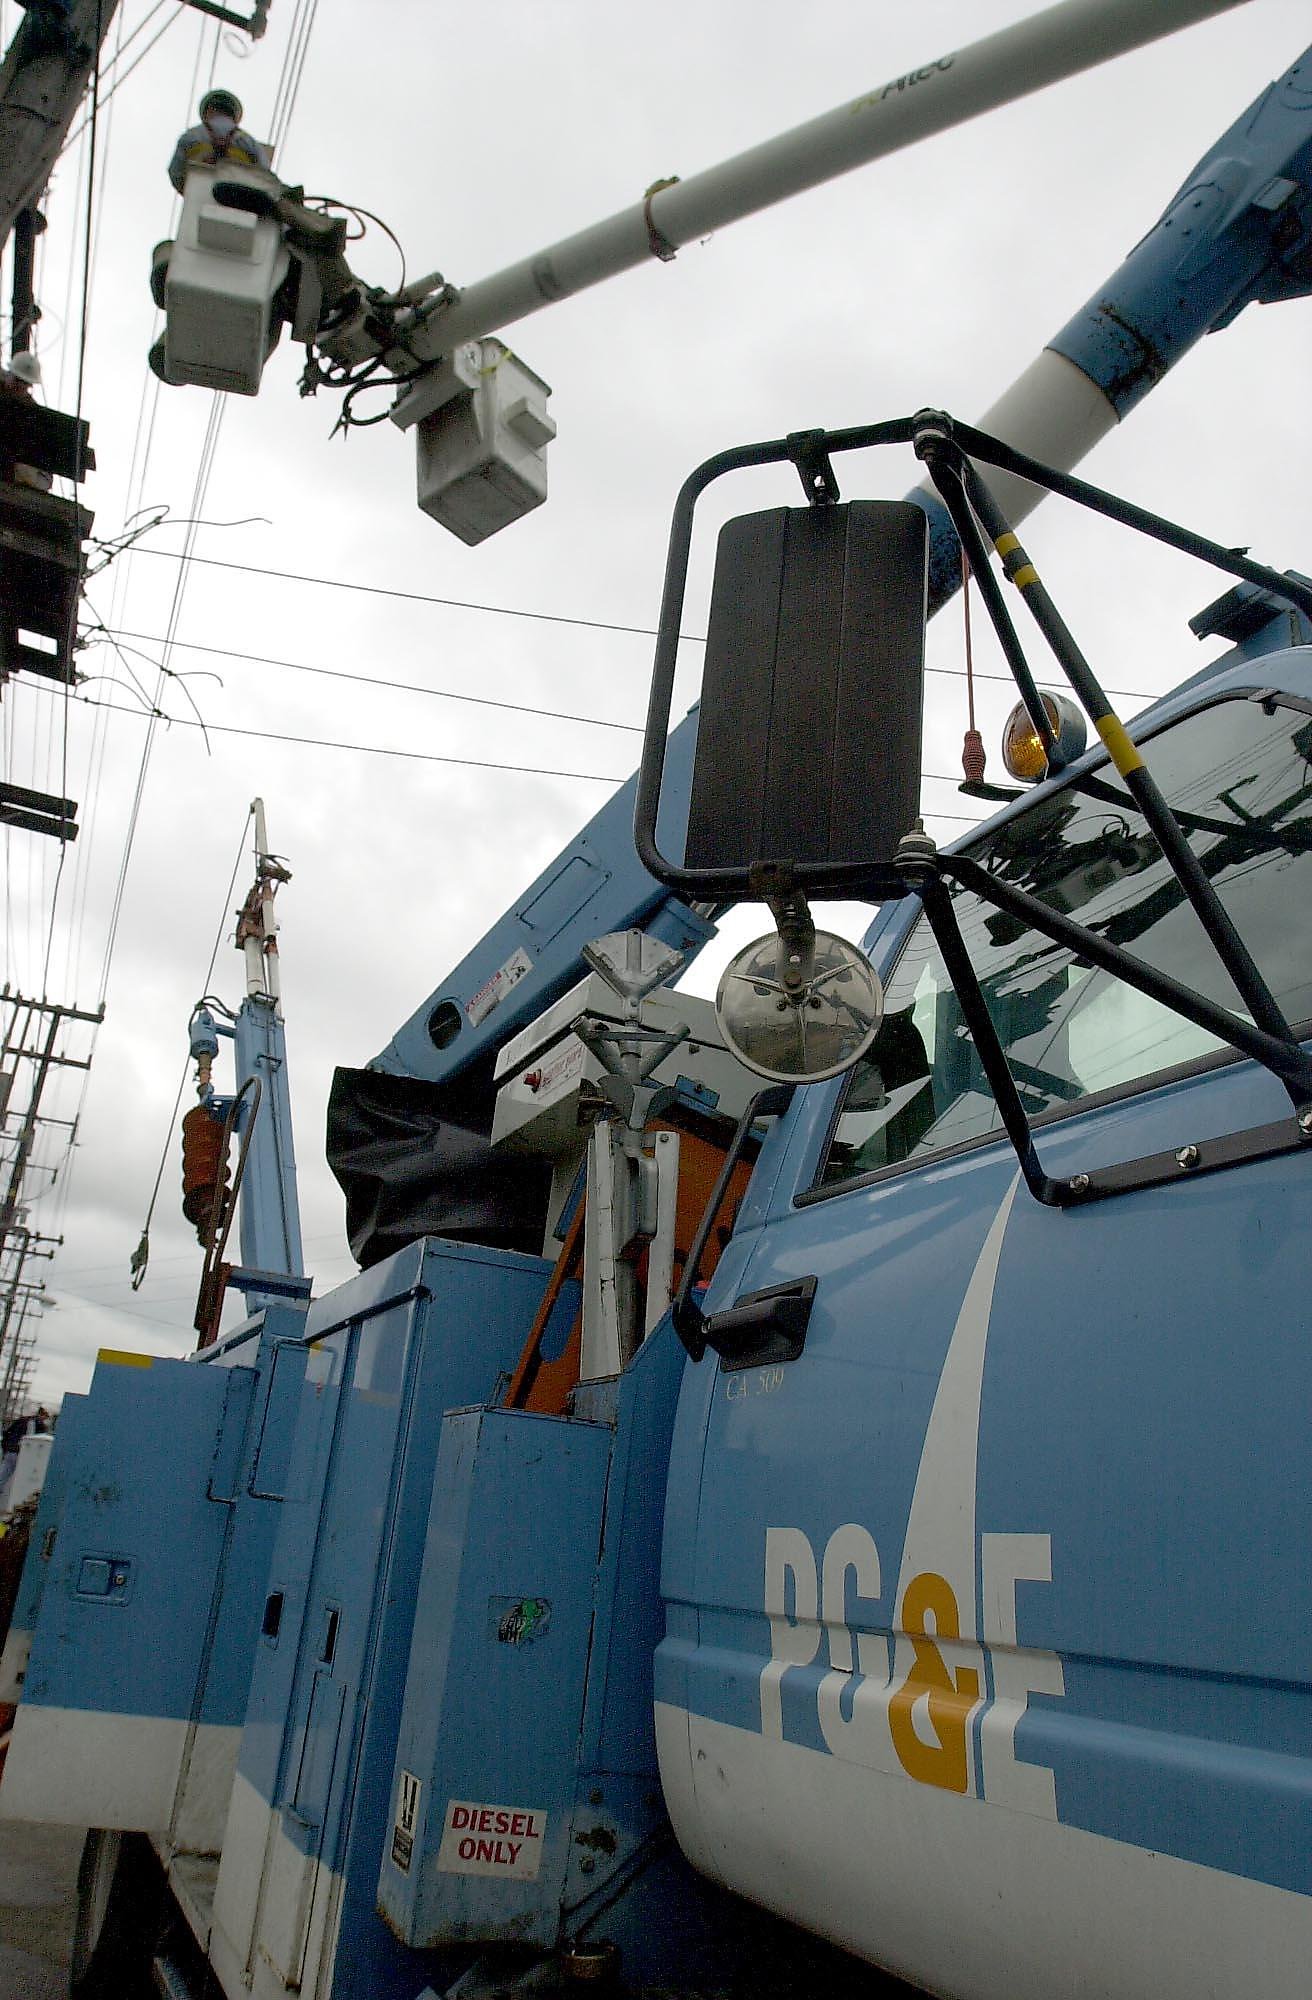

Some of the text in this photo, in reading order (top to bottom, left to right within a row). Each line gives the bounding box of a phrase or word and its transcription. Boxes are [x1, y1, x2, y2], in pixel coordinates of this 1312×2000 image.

[760, 1523, 1065, 1822] PG&E
[451, 1807, 539, 1838] DIESEL
[458, 1837, 522, 1865] ONLY
